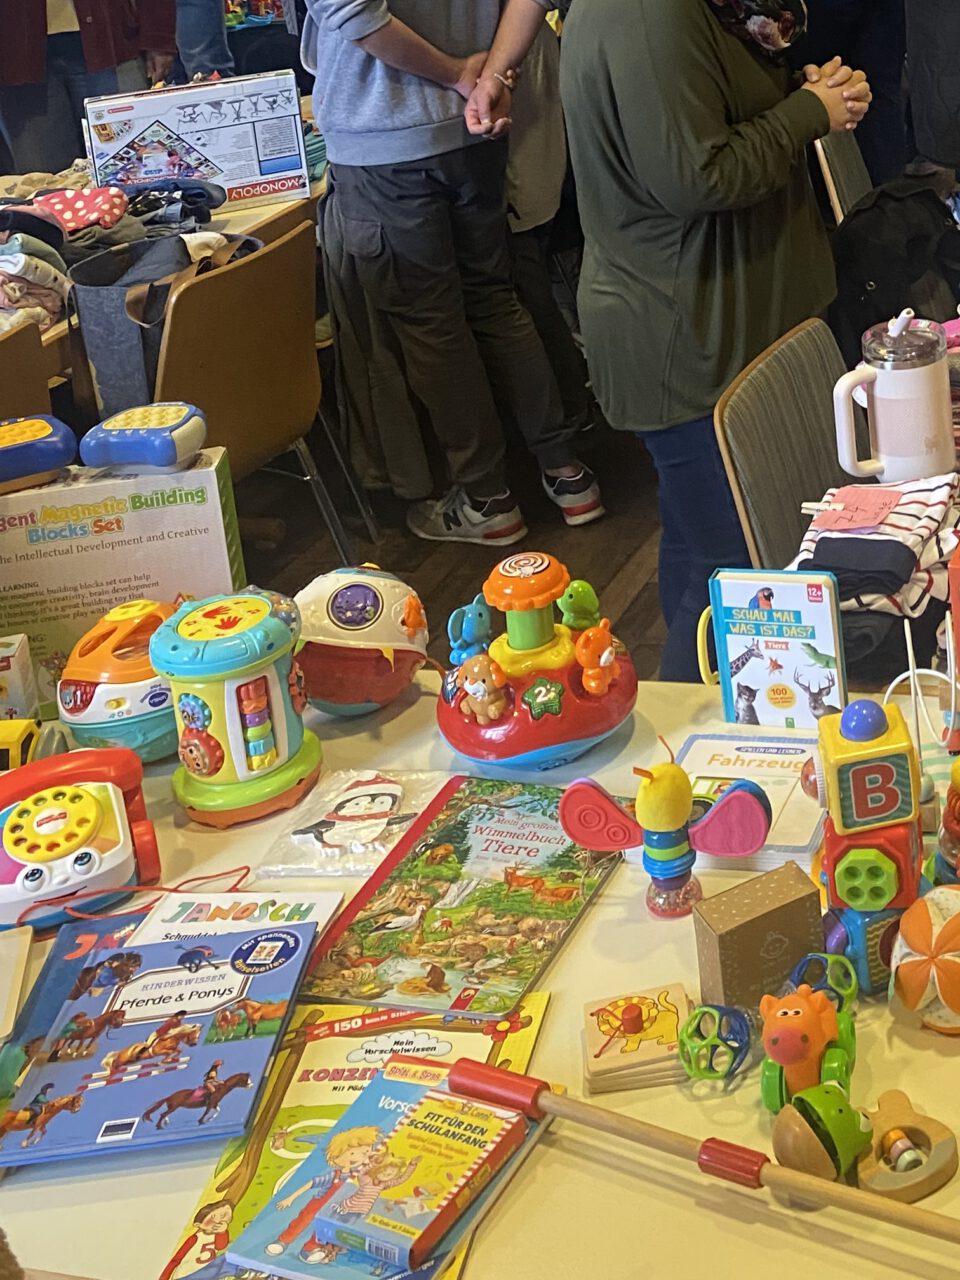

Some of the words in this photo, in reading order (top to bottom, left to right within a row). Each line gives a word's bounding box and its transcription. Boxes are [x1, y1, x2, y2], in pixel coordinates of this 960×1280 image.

[229, 180, 300, 200] MONOPOLY
[41, 497, 127, 522] Magnetic
[130, 487, 207, 511] Building
[28, 523, 89, 544] Blocks
[92, 517, 124, 536] Set
[15, 545, 73, 562] Intellectual
[76, 536, 143, 553] Development
[146, 532, 165, 543] and
[167, 527, 210, 540] Creative
[47, 584, 79, 595] building
[105, 578, 117, 586] set
[118, 577, 132, 585] can
[133, 573, 151, 584] help
[111, 581, 160, 595] development
[807, 586, 822, 596] 12+
[82, 596, 114, 608] building
[114, 595, 127, 604] toy
[128, 592, 145, 601] that
[732, 609, 768, 622] SCHAU
[772, 611, 796, 623] MAL
[729, 623, 756, 635] WAS
[760, 625, 778, 636] IST
[783, 626, 814, 638] DAS?
[533, 685, 550, 703] 2
[771, 688, 787, 696] 100
[850, 762, 900, 822] B
[472, 825, 567, 846] Wimmelbuch
[480, 838, 540, 858] Tiere
[161, 899, 317, 924] JANOSCH
[141, 973, 227, 992] KINDERWISSEN
[120, 993, 172, 1010] Pferde
[174, 993, 185, 1003] &
[188, 986, 236, 1002] Ponys
[333, 1017, 363, 1033] 150
[364, 1046, 437, 1055] Vorschulwissen
[393, 1039, 414, 1047] Mein
[406, 1118, 488, 1149] SCHULANFANG
[424, 1111, 441, 1123] FIT
[442, 1116, 464, 1129] FÜR
[463, 1123, 489, 1137] DEN
[195, 1241, 217, 1265] 5
